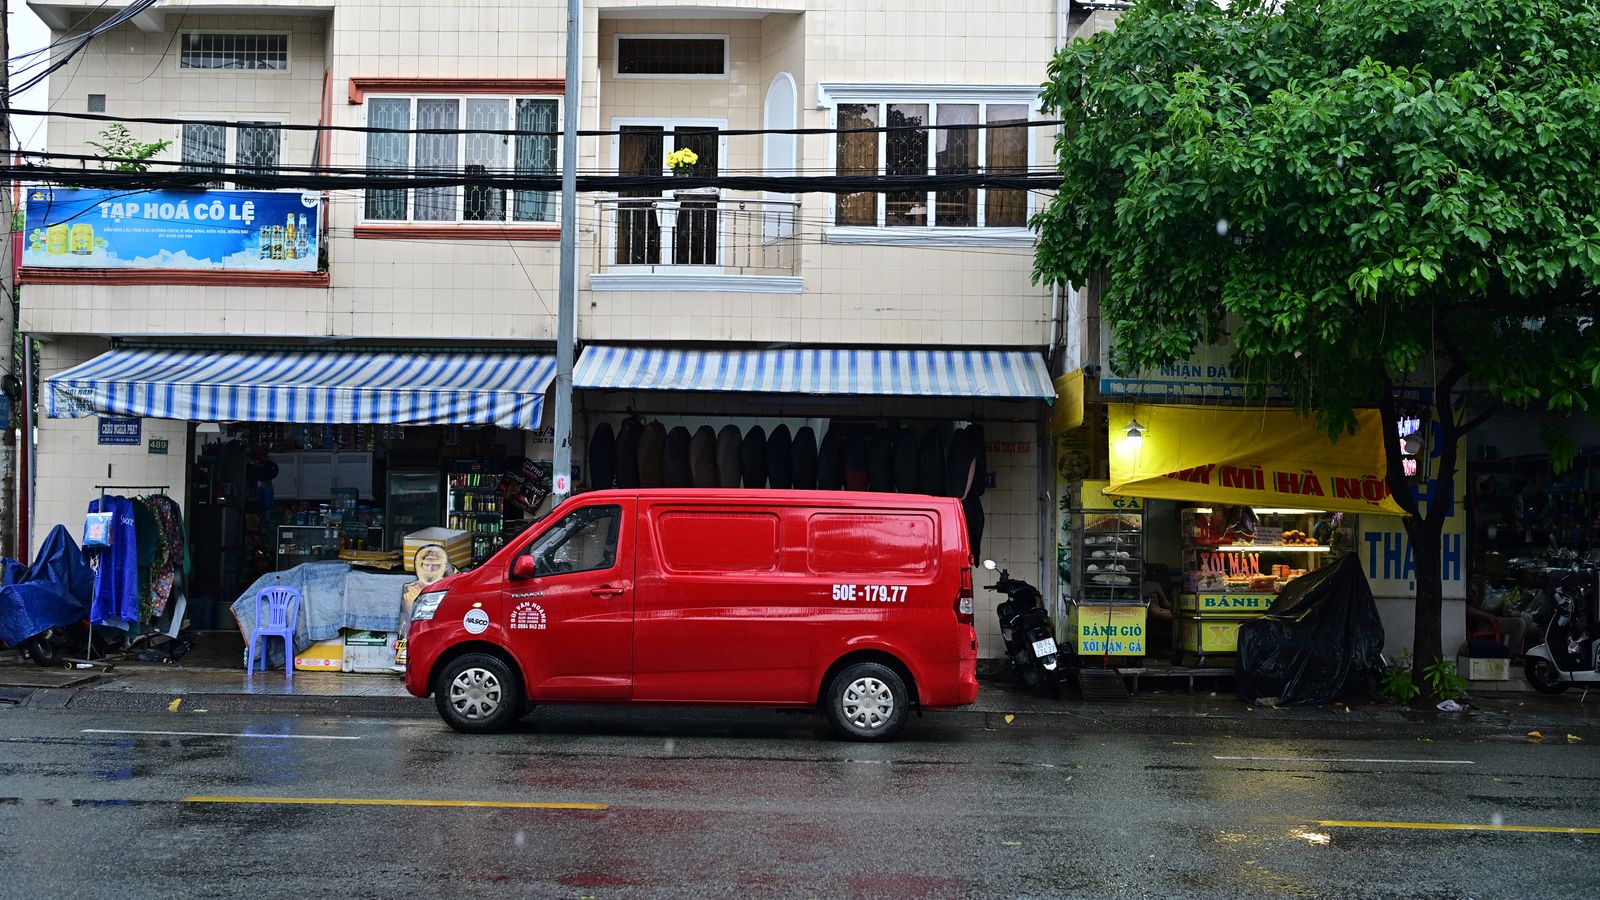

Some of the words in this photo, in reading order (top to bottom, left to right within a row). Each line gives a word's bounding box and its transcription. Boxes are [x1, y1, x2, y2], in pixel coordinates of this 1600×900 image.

[99, 202, 140, 223] TẠP
[144, 200, 190, 220] HOÁ
[194, 200, 225, 220] CÔ
[229, 201, 255, 225] LỆ
[1160, 362, 1202, 379] NHẬN
[150, 441, 167, 449] 489
[1220, 464, 1265, 490] MÌ
[1275, 469, 1325, 497] HÀ
[1365, 532, 1461, 590] THẠH
[1205, 595, 1260, 608] BÁNH
[465, 617, 488, 626] NASCO
[1083, 623, 1117, 636] BÁNH
[1121, 623, 1142, 636] GIÒ
[1083, 639, 1100, 652] XÔI
